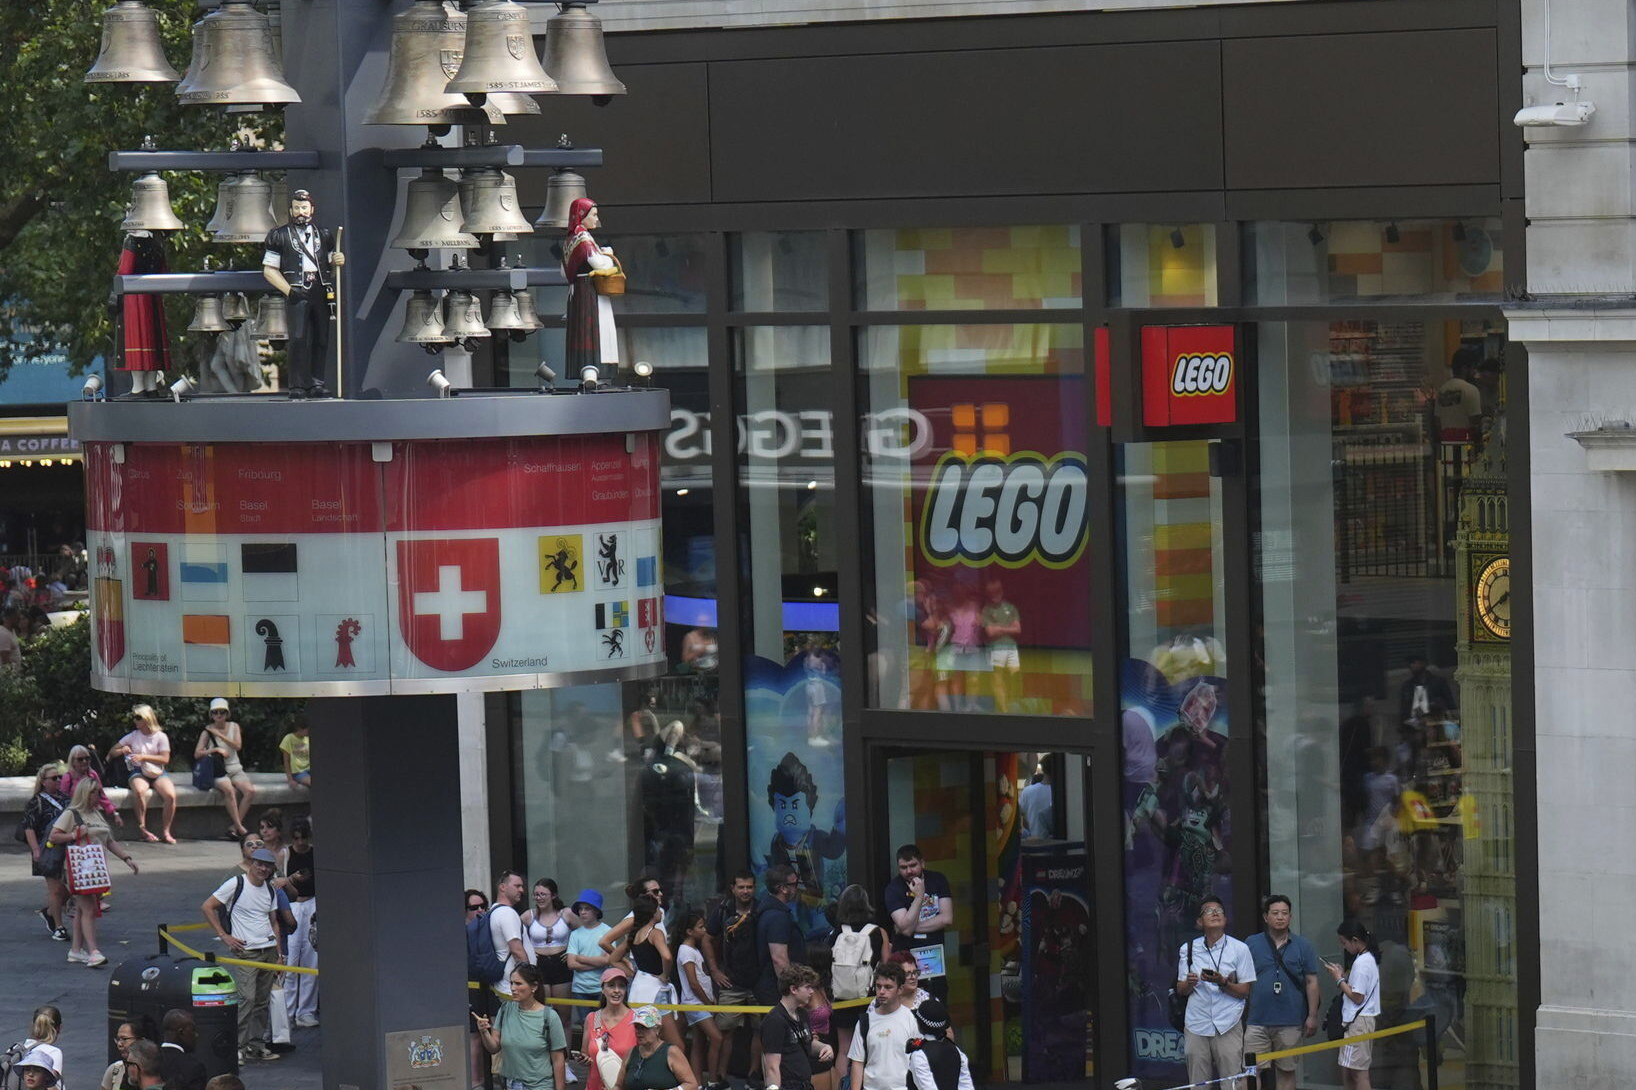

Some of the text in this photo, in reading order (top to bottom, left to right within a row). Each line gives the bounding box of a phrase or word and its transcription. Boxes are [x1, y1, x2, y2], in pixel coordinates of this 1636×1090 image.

[1172, 353, 1231, 395] LEGO
[17, 438, 79, 451] COFFEE
[238, 468, 282, 482] Fribourg
[239, 500, 268, 511] Basel
[312, 499, 342, 511] Basel
[929, 457, 1088, 557] LEGO
[597, 558, 626, 576] V R
[132, 661, 179, 673] Liechtenstein
[492, 656, 548, 669] Switzerland
